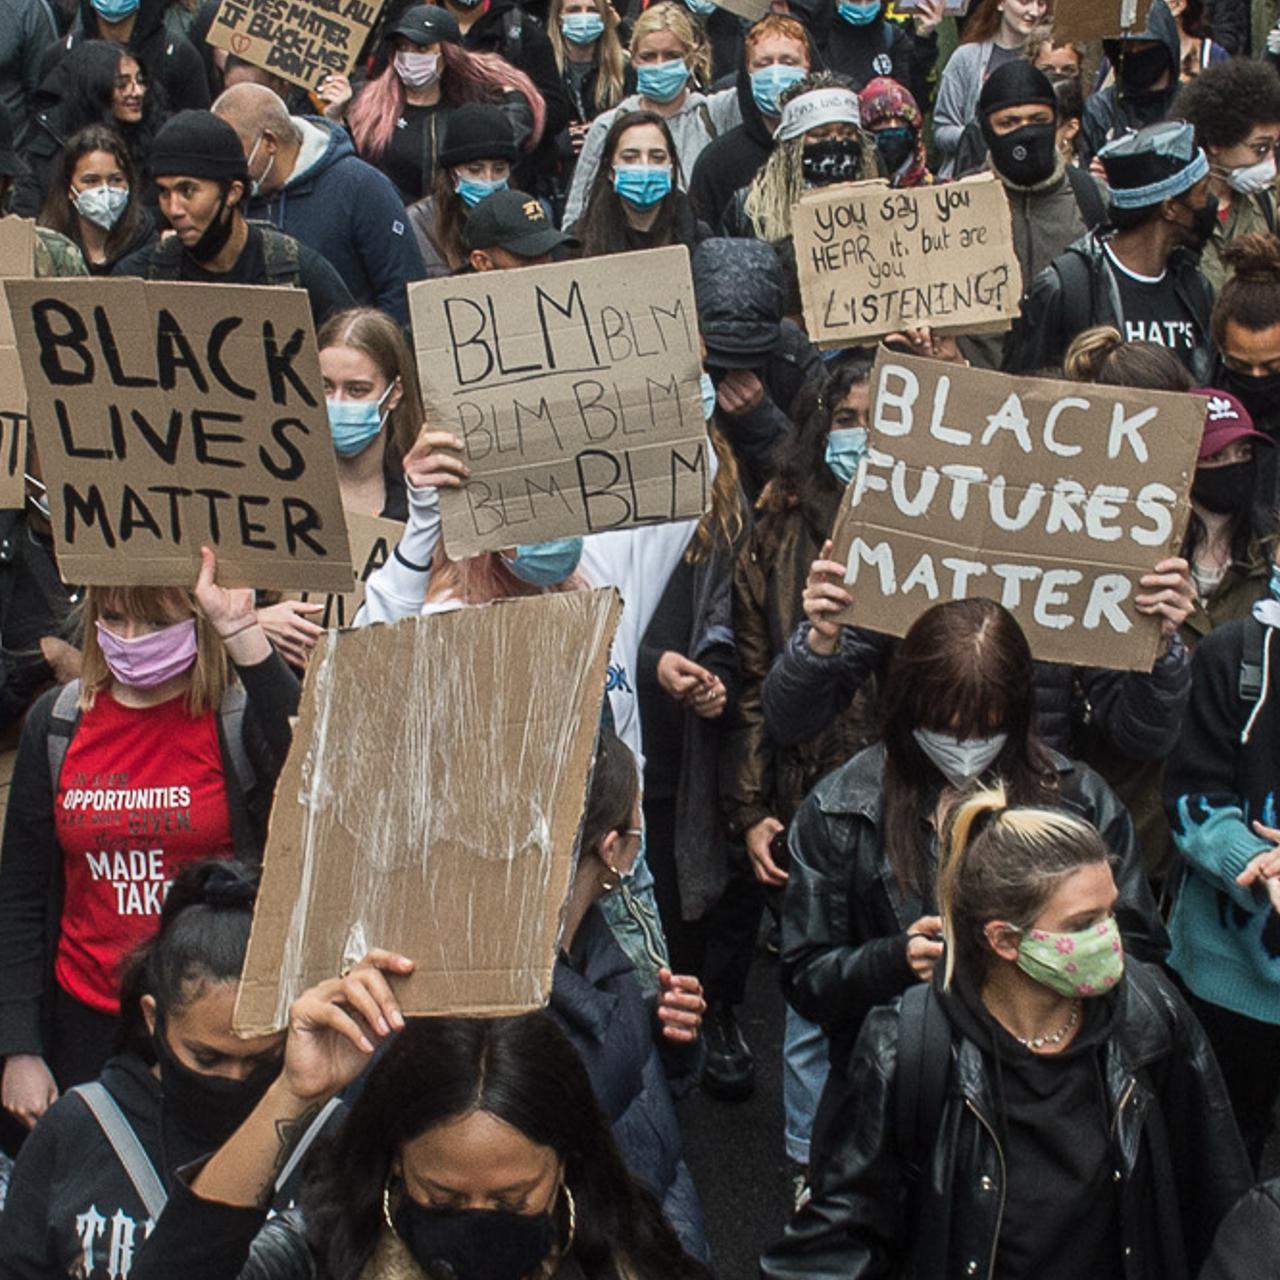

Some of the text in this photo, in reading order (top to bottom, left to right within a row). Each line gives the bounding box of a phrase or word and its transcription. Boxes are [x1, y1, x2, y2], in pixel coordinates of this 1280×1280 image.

[812, 234, 876, 273] HEAR
[921, 227, 950, 254] but
[960, 225, 987, 248] are
[813, 188, 971, 242] you say you
[823, 264, 1009, 329] LISTENING?
[868, 261, 906, 288] you
[31, 297, 320, 408] BLACK
[443, 280, 695, 387] BLM BLM
[53, 398, 312, 483] LIVES
[456, 374, 684, 462] BLM BLM
[874, 362, 1161, 464] BLACK
[62, 483, 328, 557] MATTER
[465, 447, 709, 537] BLM BLM
[852, 450, 1178, 548] FUTURES
[844, 536, 1134, 634] MATTER
[63, 786, 191, 811] OPPORTUNITIES
[85, 849, 164, 880] MADE
